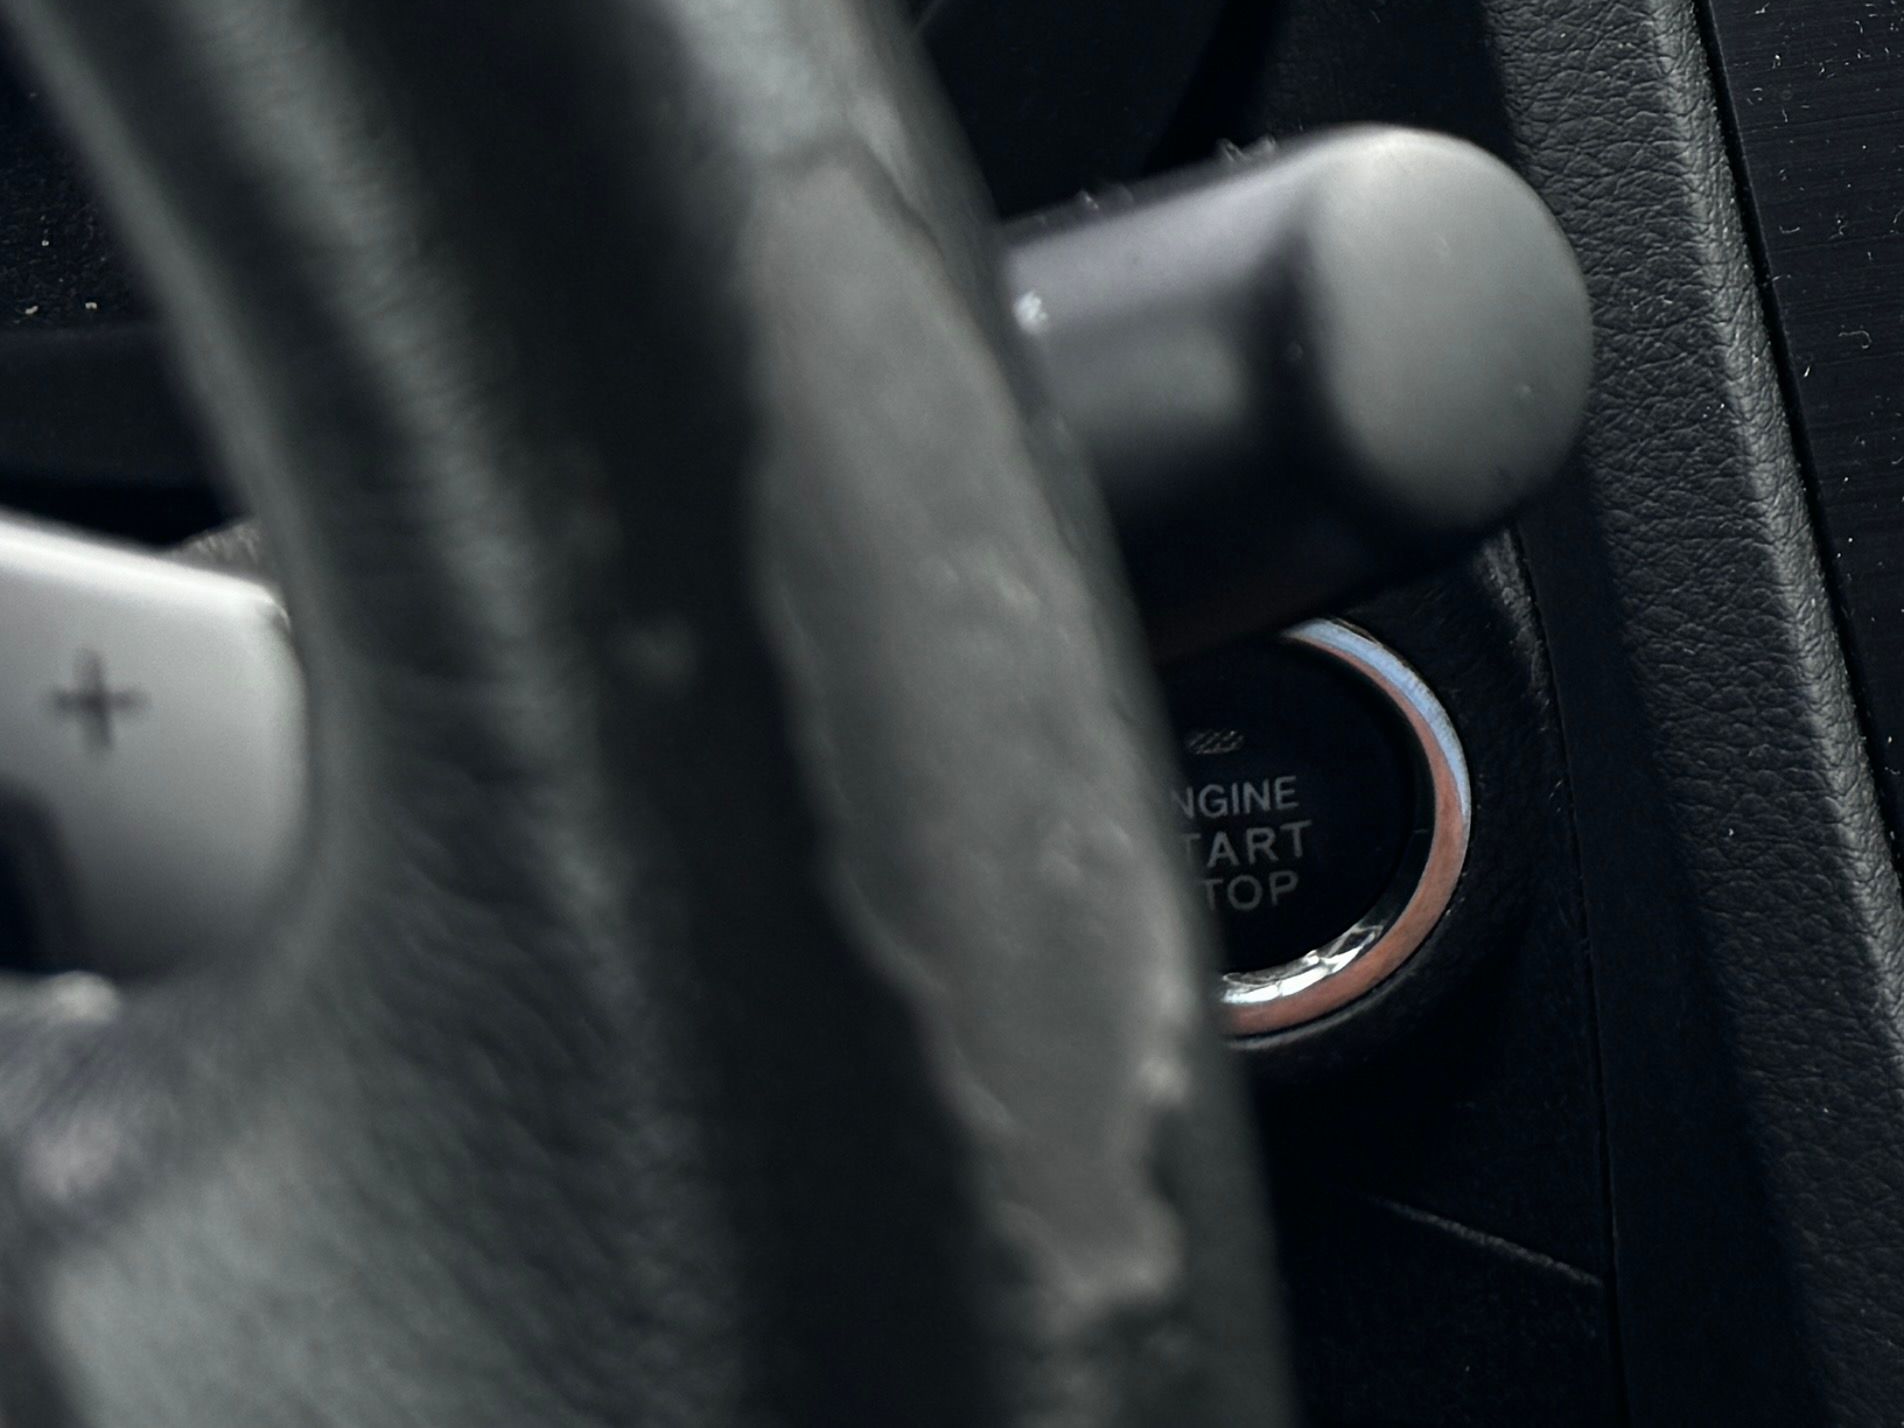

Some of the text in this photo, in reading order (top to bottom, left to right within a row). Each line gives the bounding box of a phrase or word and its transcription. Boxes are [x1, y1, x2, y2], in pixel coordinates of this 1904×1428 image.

[1170, 775, 1299, 819] NGINE
[1180, 819, 1313, 868] TART
[1198, 869, 1299, 911] TOP
